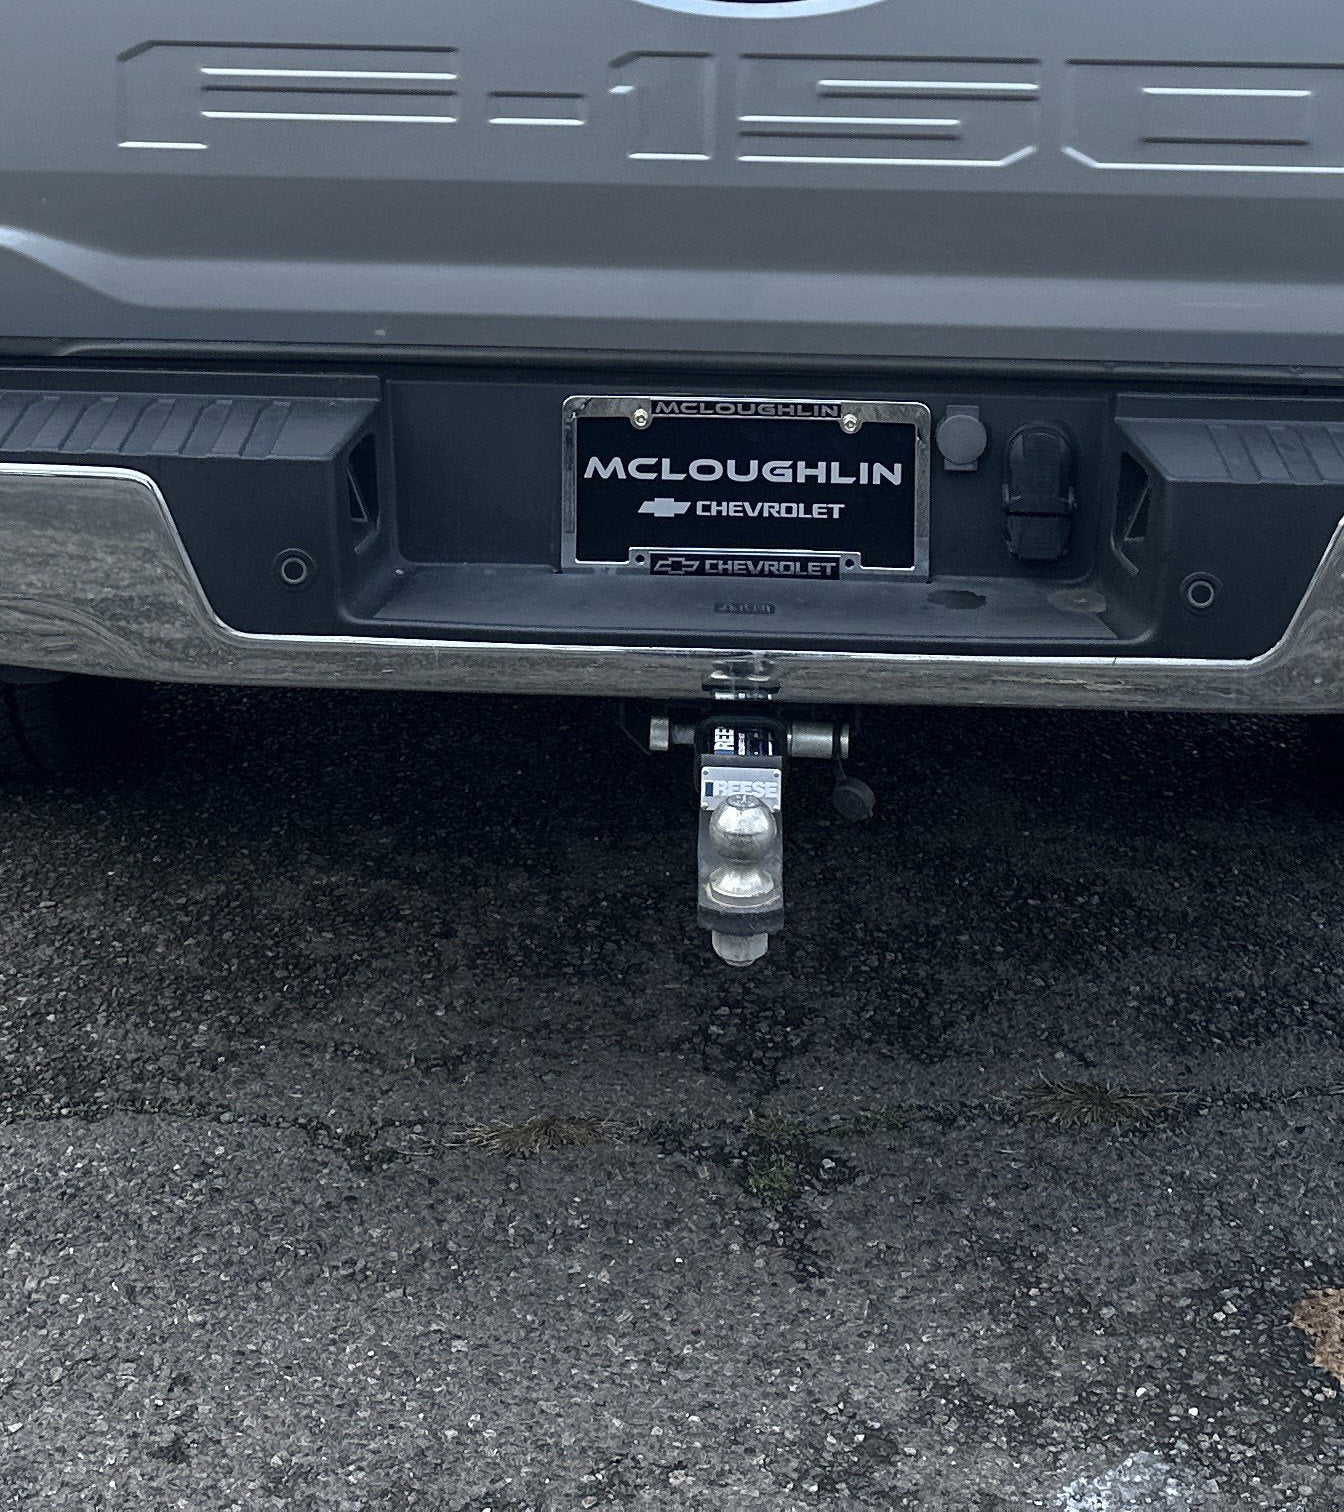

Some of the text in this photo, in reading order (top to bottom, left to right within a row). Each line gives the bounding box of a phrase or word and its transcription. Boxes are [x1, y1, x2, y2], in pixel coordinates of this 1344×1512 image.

[656, 401, 839, 417] MCLOUGHLIN
[584, 456, 902, 485] MCLOUGHLIN
[696, 500, 845, 519] CHEVROLET
[704, 560, 836, 576] CHEVROLET
[714, 727, 735, 751] REE
[713, 780, 778, 798] REESE
